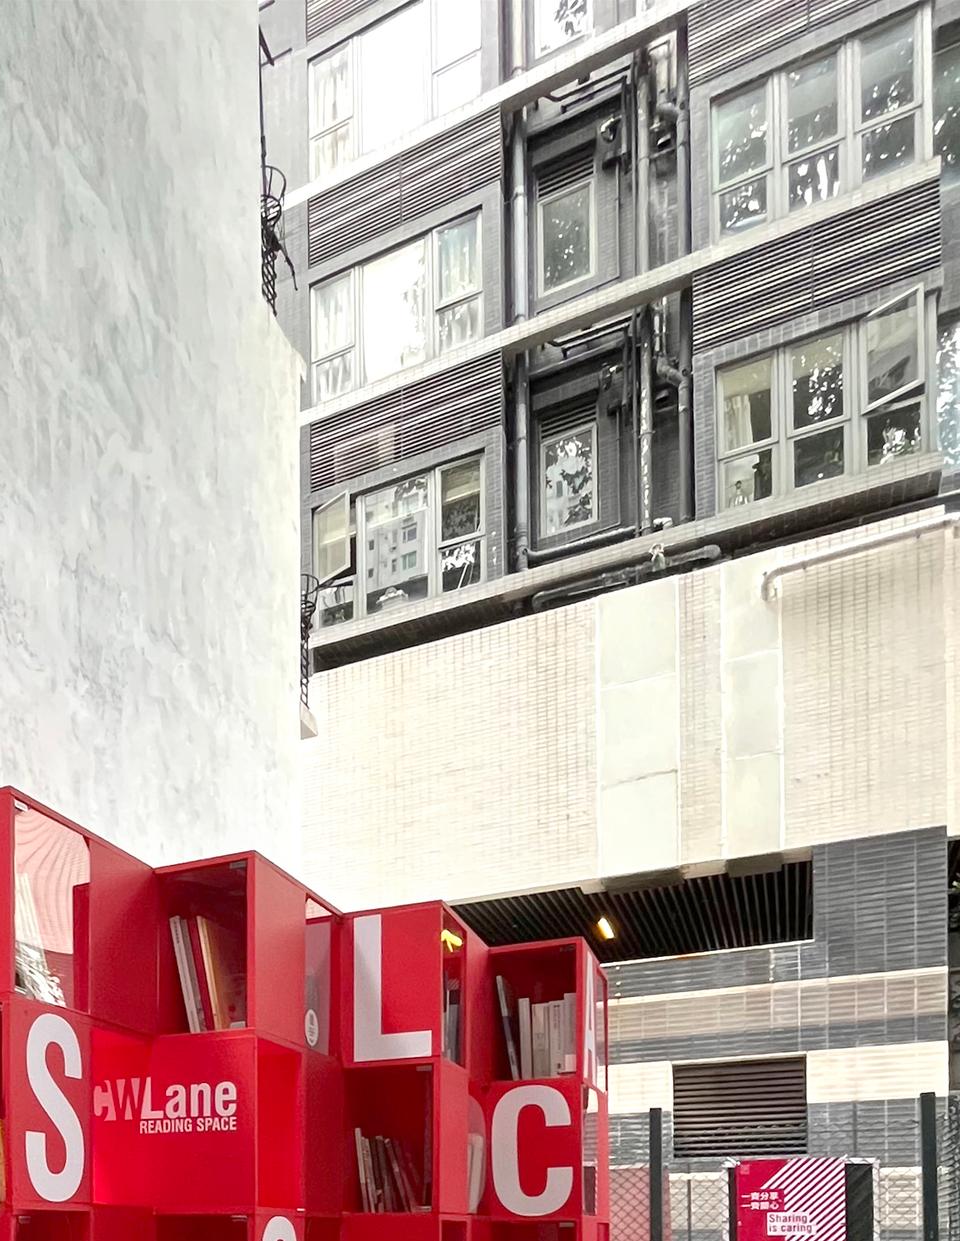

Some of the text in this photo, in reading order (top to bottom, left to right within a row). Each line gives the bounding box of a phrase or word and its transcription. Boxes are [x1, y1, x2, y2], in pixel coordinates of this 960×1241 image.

[353, 913, 433, 1062] L
[25, 1012, 85, 1203] S
[139, 1116, 238, 1135] READING SPACE
[492, 1084, 574, 1217] C
[768, 1213, 808, 1224] Sharing
[768, 1224, 813, 1234] is caring
